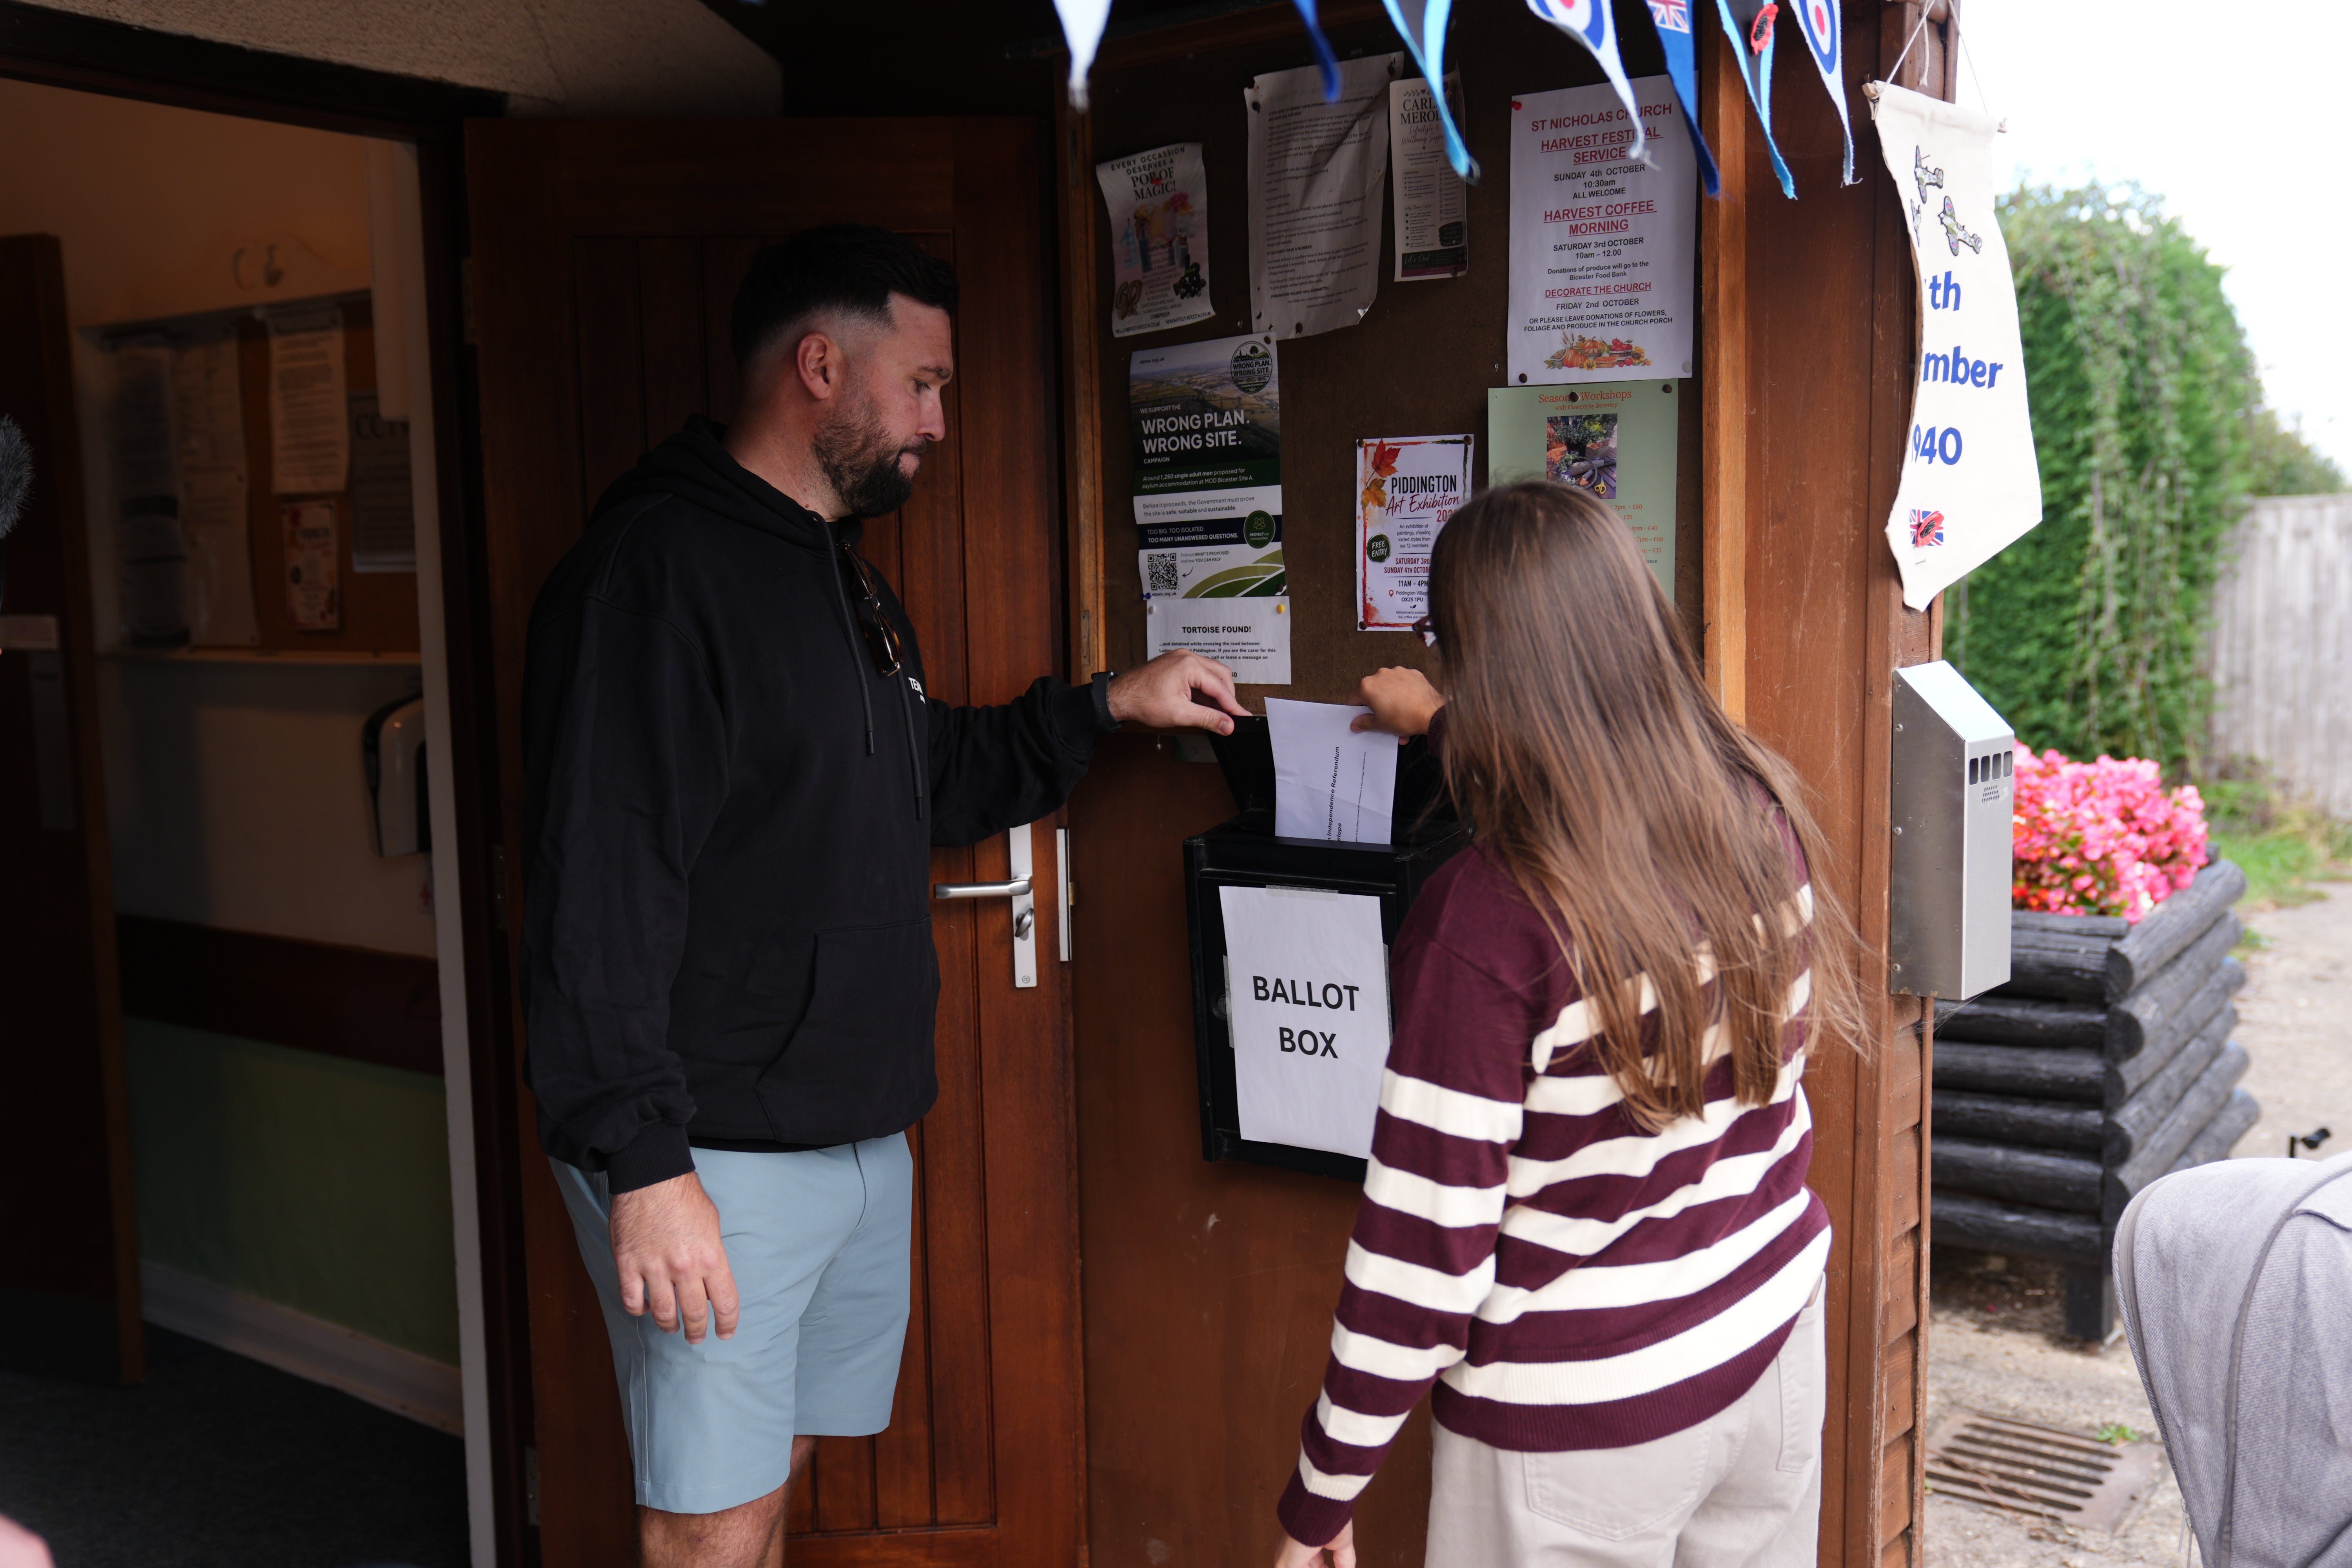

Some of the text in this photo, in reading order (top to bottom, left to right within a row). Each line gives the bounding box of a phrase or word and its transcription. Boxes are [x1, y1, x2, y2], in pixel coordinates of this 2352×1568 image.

[1403, 97, 1437, 111] CARL
[1401, 110, 1441, 124] MEROL
[1532, 120, 1547, 131] ST
[1550, 111, 1613, 129] NICHOLAS
[1409, 124, 1434, 135] Lifestyle
[1402, 135, 1426, 145] Wellbeing
[1541, 126, 1660, 151] HARVEST FESTIAL
[1111, 147, 1185, 170] EVERY OCCASSION
[1574, 147, 1626, 163] SERVICE
[1127, 162, 1166, 175] DESERVES
[1554, 171, 1586, 181] SUNDAY
[1606, 164, 1645, 175] OCTOBER
[1132, 172, 1157, 187] POP
[1584, 179, 1615, 189] 10:30am
[1134, 181, 1176, 200] MAGIC!
[1589, 188, 1626, 198] WELCOME
[1545, 200, 1654, 221] HARVEST COFFEE
[1569, 219, 1629, 235] MORNING
[1553, 242, 1592, 252] SATURDAY
[1608, 238, 1644, 247] OCTOBER
[1545, 287, 1592, 297] DECORATE
[1613, 282, 1651, 292] CHURCH
[1929, 270, 1961, 311] th
[1603, 298, 1639, 307] OCTOBER
[1923, 345, 2003, 389] mber
[1539, 390, 1632, 403] Season Workshops
[1142, 410, 1250, 435] WRONG PLAN.
[1143, 430, 1241, 454] WRONG SITE.
[1913, 423, 1962, 466] 940
[1392, 475, 1456, 494] PIDDINGTON
[1386, 493, 1459, 516] Art Exhibition
[1372, 541, 1387, 557] FREE ENTRY
[1253, 976, 1359, 1011] BALLOT
[1279, 1027, 1338, 1058] BOX
